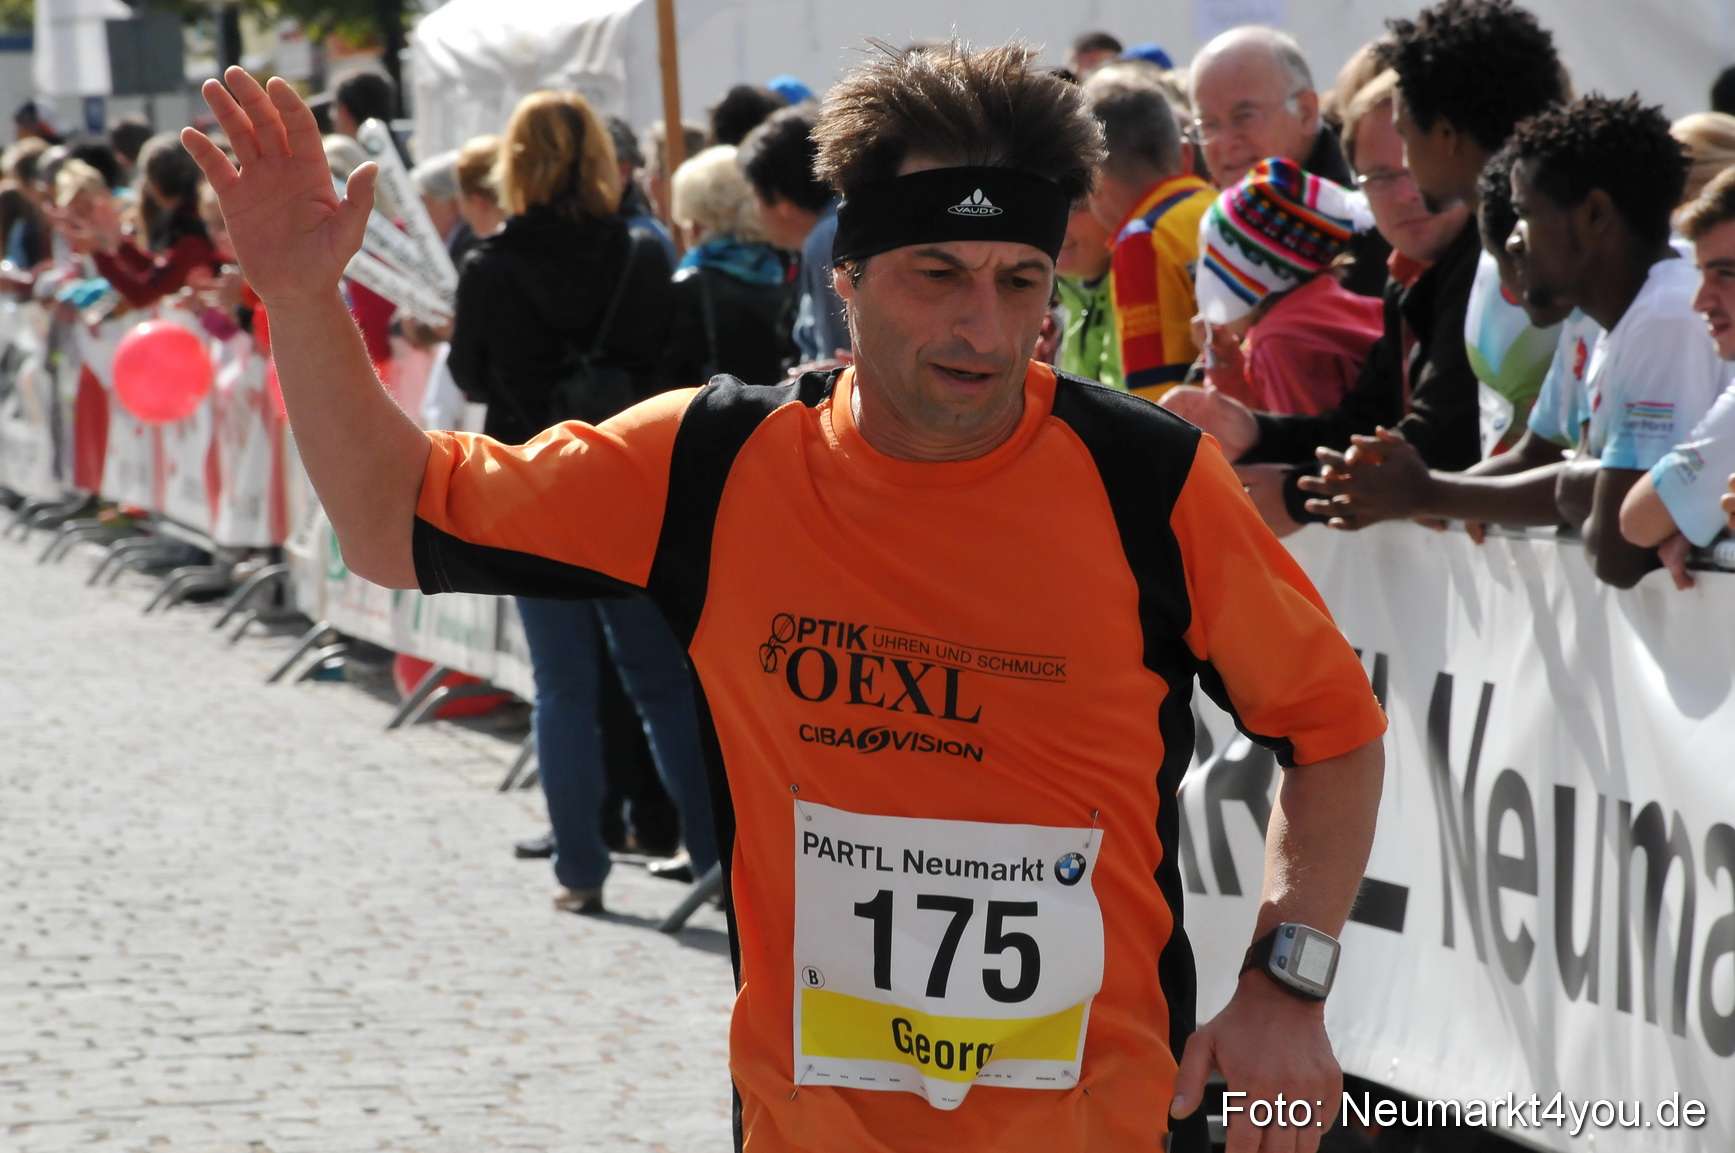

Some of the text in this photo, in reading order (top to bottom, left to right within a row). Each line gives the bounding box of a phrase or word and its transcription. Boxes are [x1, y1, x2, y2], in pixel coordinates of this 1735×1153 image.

[872, 632, 1067, 678] UHREN UND SCHMUCK
[785, 646, 983, 724] OEXL
[798, 723, 983, 762] CIBA VISION
[802, 831, 1044, 882] PARTL Neumarkt
[854, 889, 1041, 1004] 175
[808, 968, 820, 986] B
